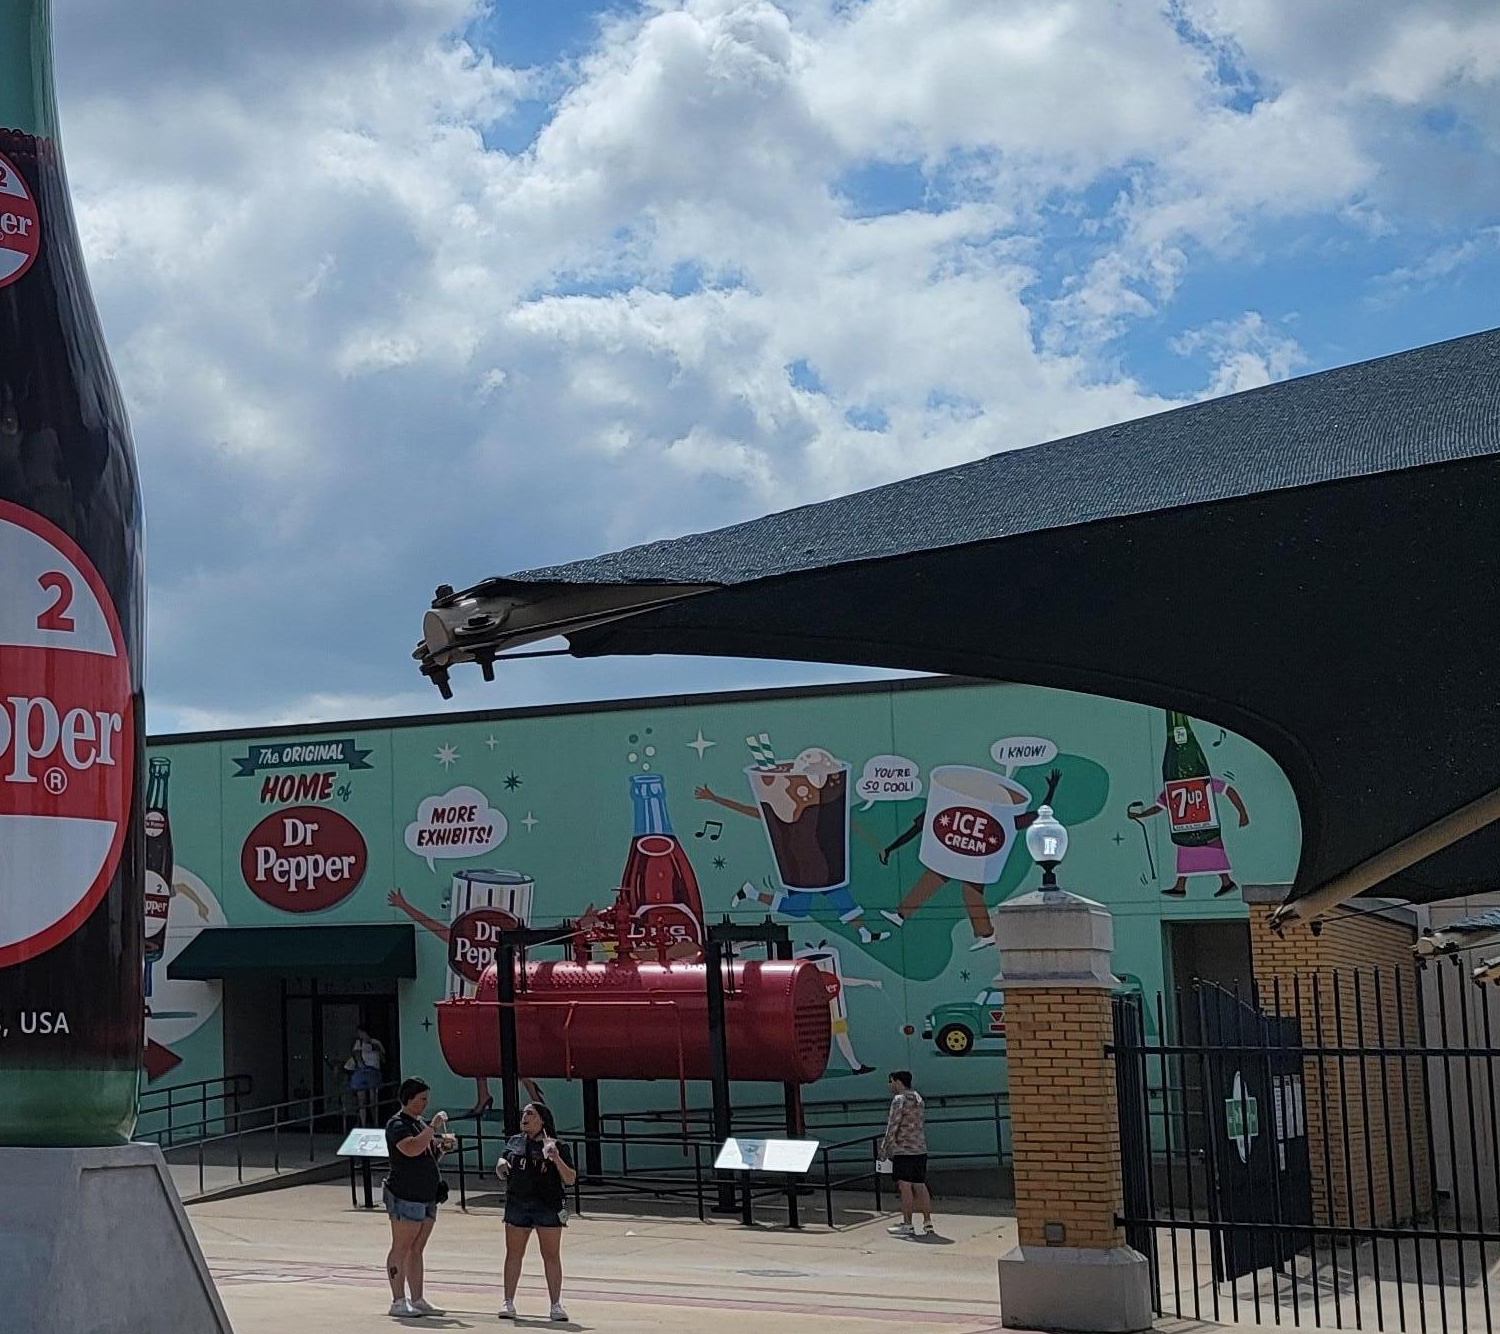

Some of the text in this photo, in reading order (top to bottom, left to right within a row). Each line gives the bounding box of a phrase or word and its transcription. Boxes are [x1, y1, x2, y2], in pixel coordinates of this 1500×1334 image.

[36, 570, 76, 634] 2
[258, 743, 344, 766] The ORIGINAL
[999, 744, 1047, 759] I KNOW!
[873, 767, 912, 779] YOU'RE
[260, 771, 353, 805] HOME of
[862, 780, 914, 792] SO COOL!
[431, 805, 478, 825] MORE
[952, 810, 989, 839] ICE
[282, 817, 320, 847] Dr
[416, 825, 494, 847] EXHIBITS!
[944, 833, 987, 854] CREAM
[255, 846, 357, 892] Pepper
[145, 900, 168, 914] pper
[20, 1011, 70, 1035] USA
